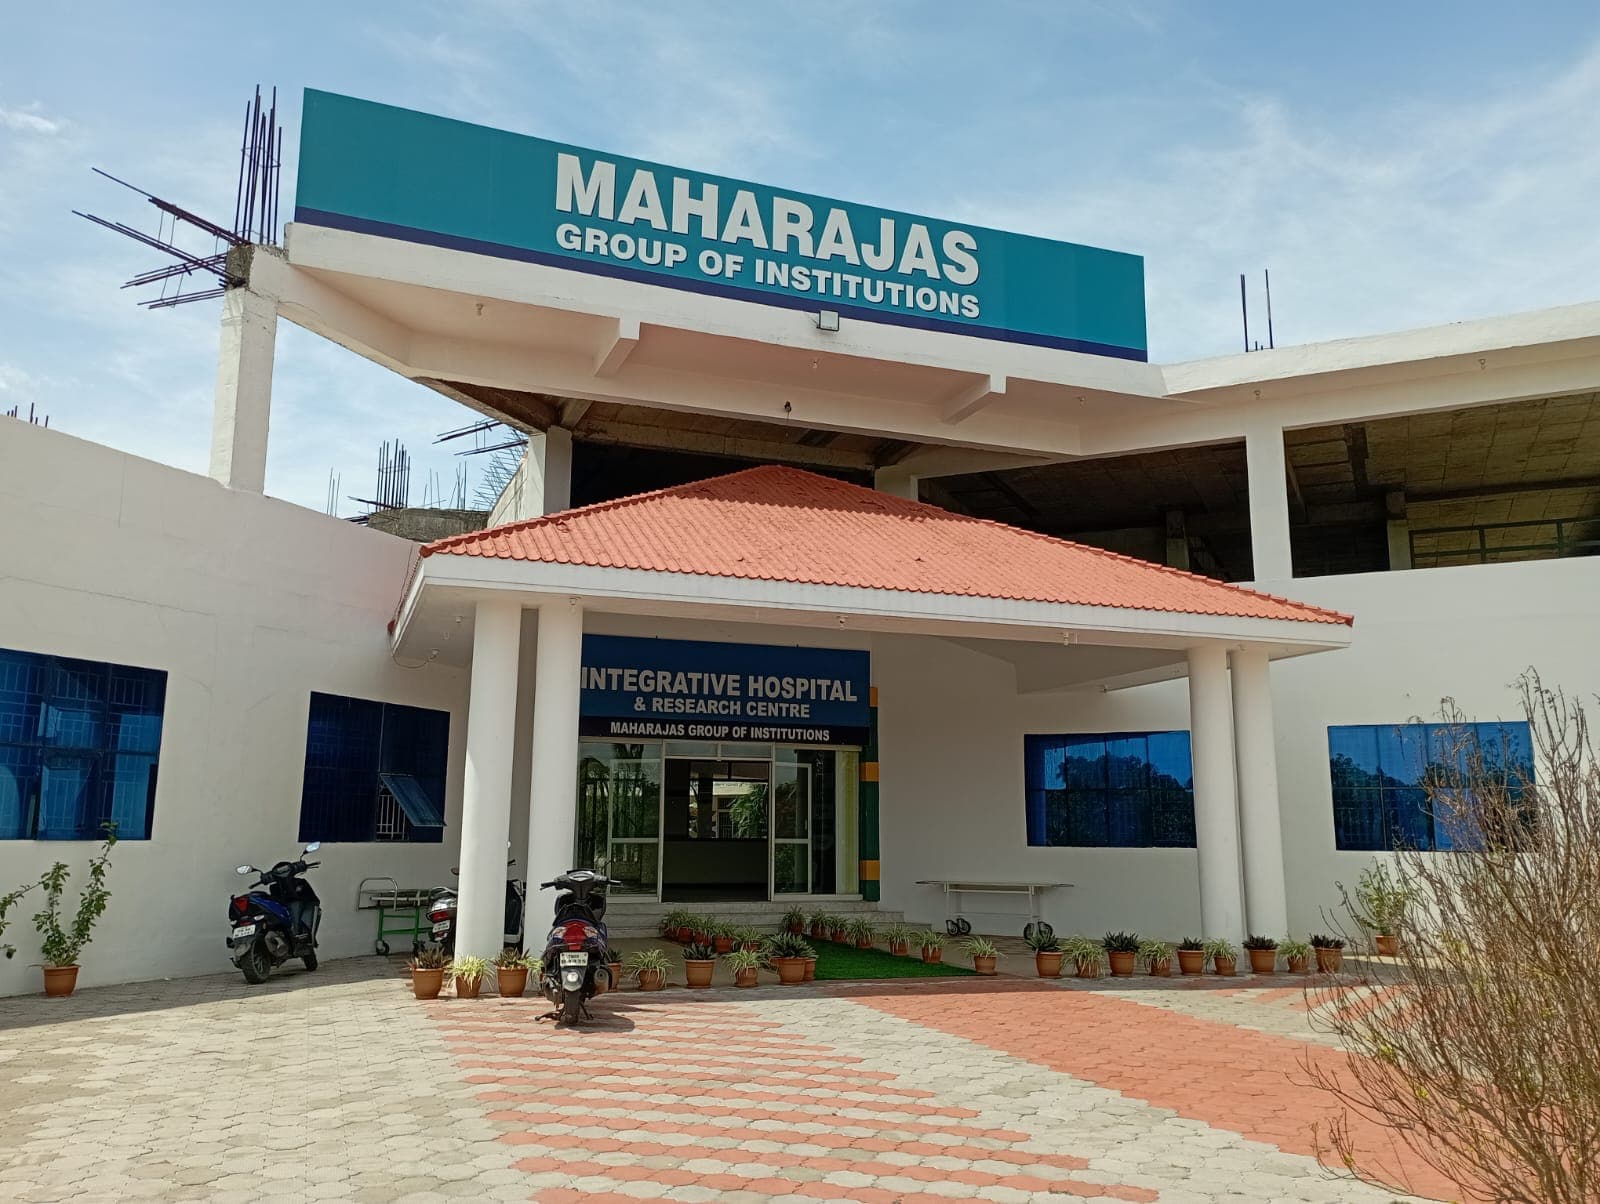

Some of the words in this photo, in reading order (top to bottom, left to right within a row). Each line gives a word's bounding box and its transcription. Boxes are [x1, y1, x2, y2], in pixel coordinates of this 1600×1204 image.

[555, 152, 980, 286] MAHARAJAS
[556, 223, 687, 268] GROUP
[699, 250, 744, 278] OF
[755, 259, 980, 319] INSTITUTIONS
[580, 666, 741, 697] INTEGRATIVE
[748, 675, 858, 702] HOSPITAL
[634, 696, 646, 711] &
[652, 697, 741, 716] RESEARCH
[746, 701, 810, 718] CENTRE
[610, 721, 685, 736] MAHARAJAS
[688, 725, 729, 738] GROUP
[732, 726, 748, 738] OF
[750, 727, 830, 741] INSTITUTIONS
